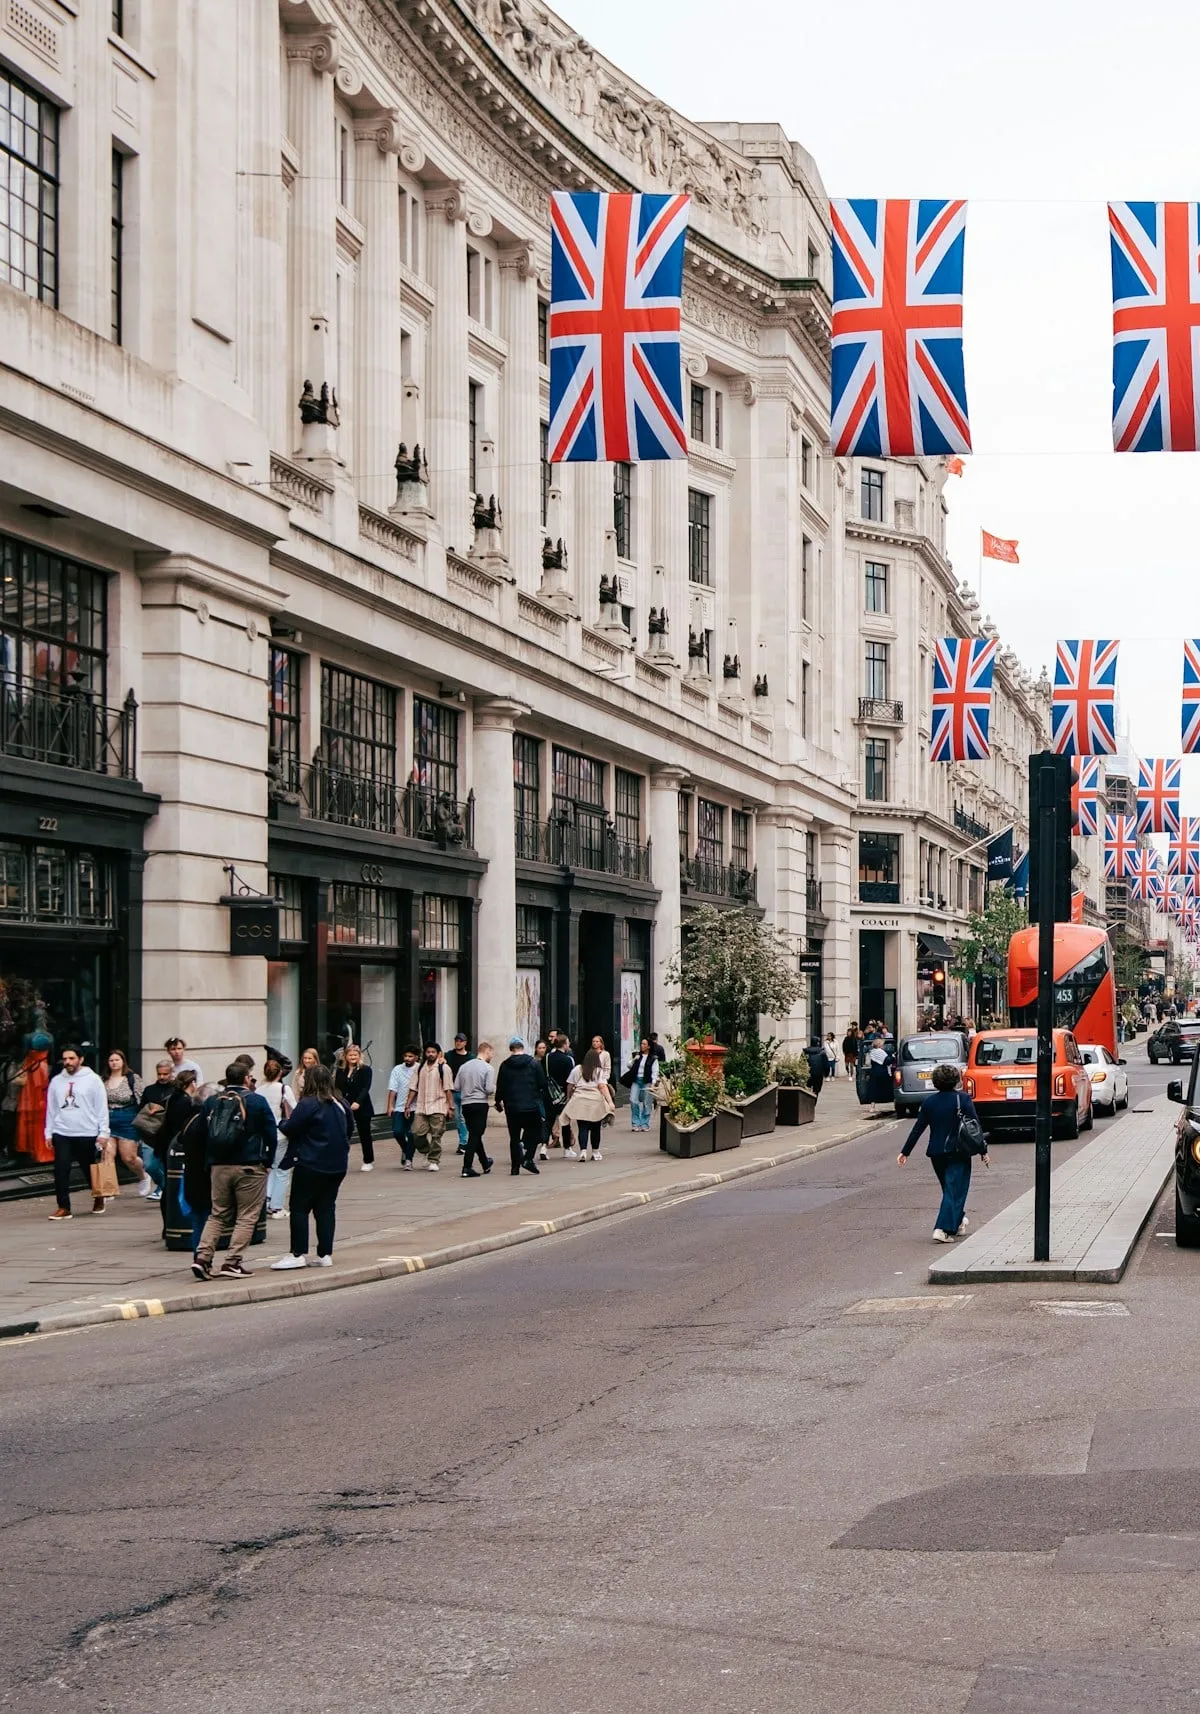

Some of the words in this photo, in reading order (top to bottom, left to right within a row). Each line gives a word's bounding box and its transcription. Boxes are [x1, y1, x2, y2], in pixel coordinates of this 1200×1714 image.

[39, 816, 58, 831] 222
[361, 863, 384, 883] COS
[861, 919, 899, 927] COACH
[235, 924, 273, 938] COS
[1056, 989, 1073, 1002] 453
